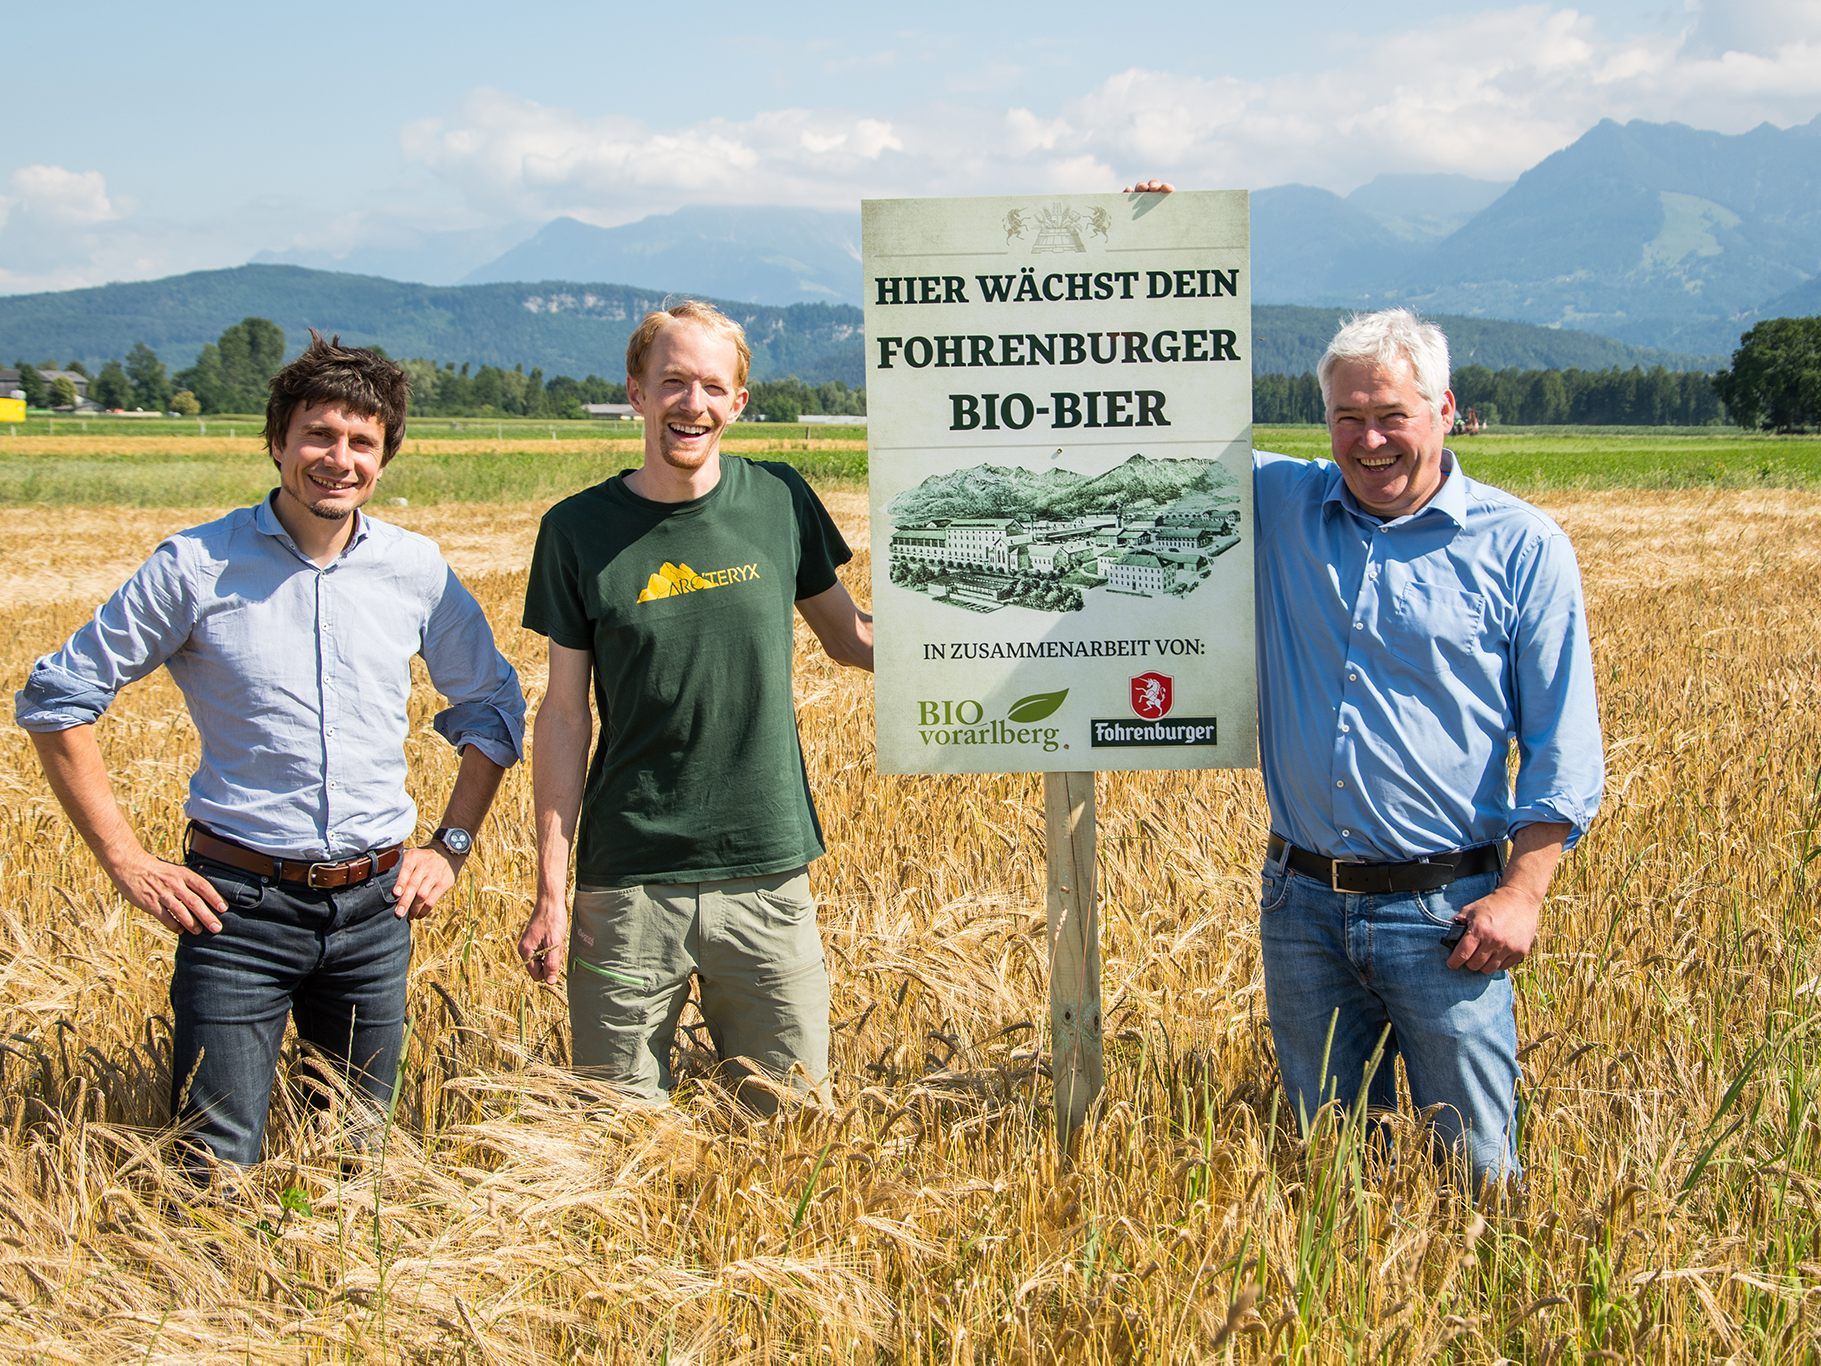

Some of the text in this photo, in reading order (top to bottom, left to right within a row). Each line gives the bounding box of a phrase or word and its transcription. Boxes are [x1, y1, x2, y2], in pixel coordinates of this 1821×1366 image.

[875, 266, 1240, 305] HIER WÄCHST DEIN
[877, 329, 1242, 369] FOHRENBURGER
[949, 390, 1172, 431] BIO-BIER
[669, 563, 761, 597] ARC'TERYX
[923, 638, 1206, 660] IN ZUSAMMENARBEIT VON:
[918, 700, 984, 727] BIO
[918, 720, 1060, 753] vorarlberg
[1095, 722, 1215, 744] Fohrenburger
